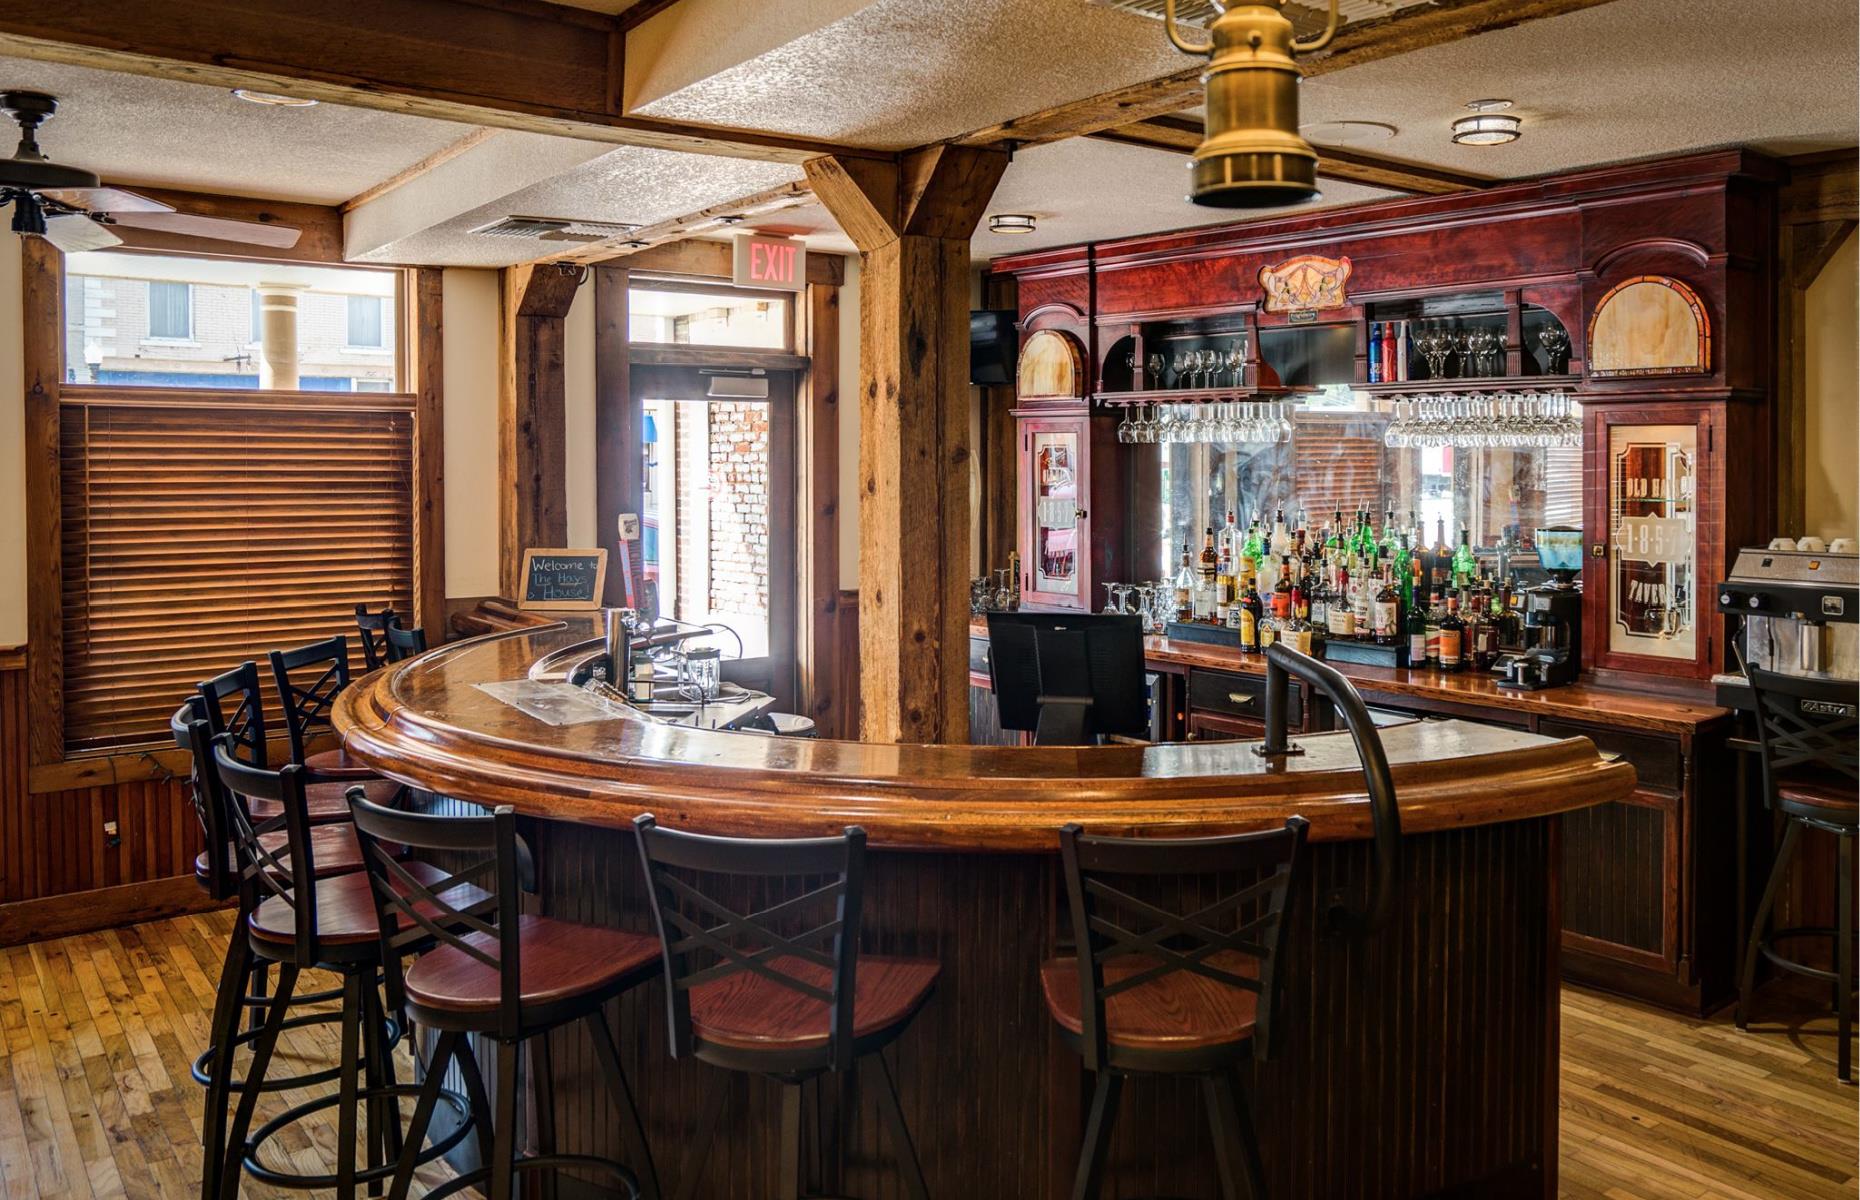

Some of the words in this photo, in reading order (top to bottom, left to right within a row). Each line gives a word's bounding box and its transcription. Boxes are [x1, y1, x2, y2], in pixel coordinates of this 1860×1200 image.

[751, 243, 796, 282] EXIT
[1627, 478, 1647, 498] OLD
[532, 558, 584, 571] Welcome
[590, 561, 598, 569] to
[532, 573, 552, 585] The
[558, 572, 587, 587] Hays
